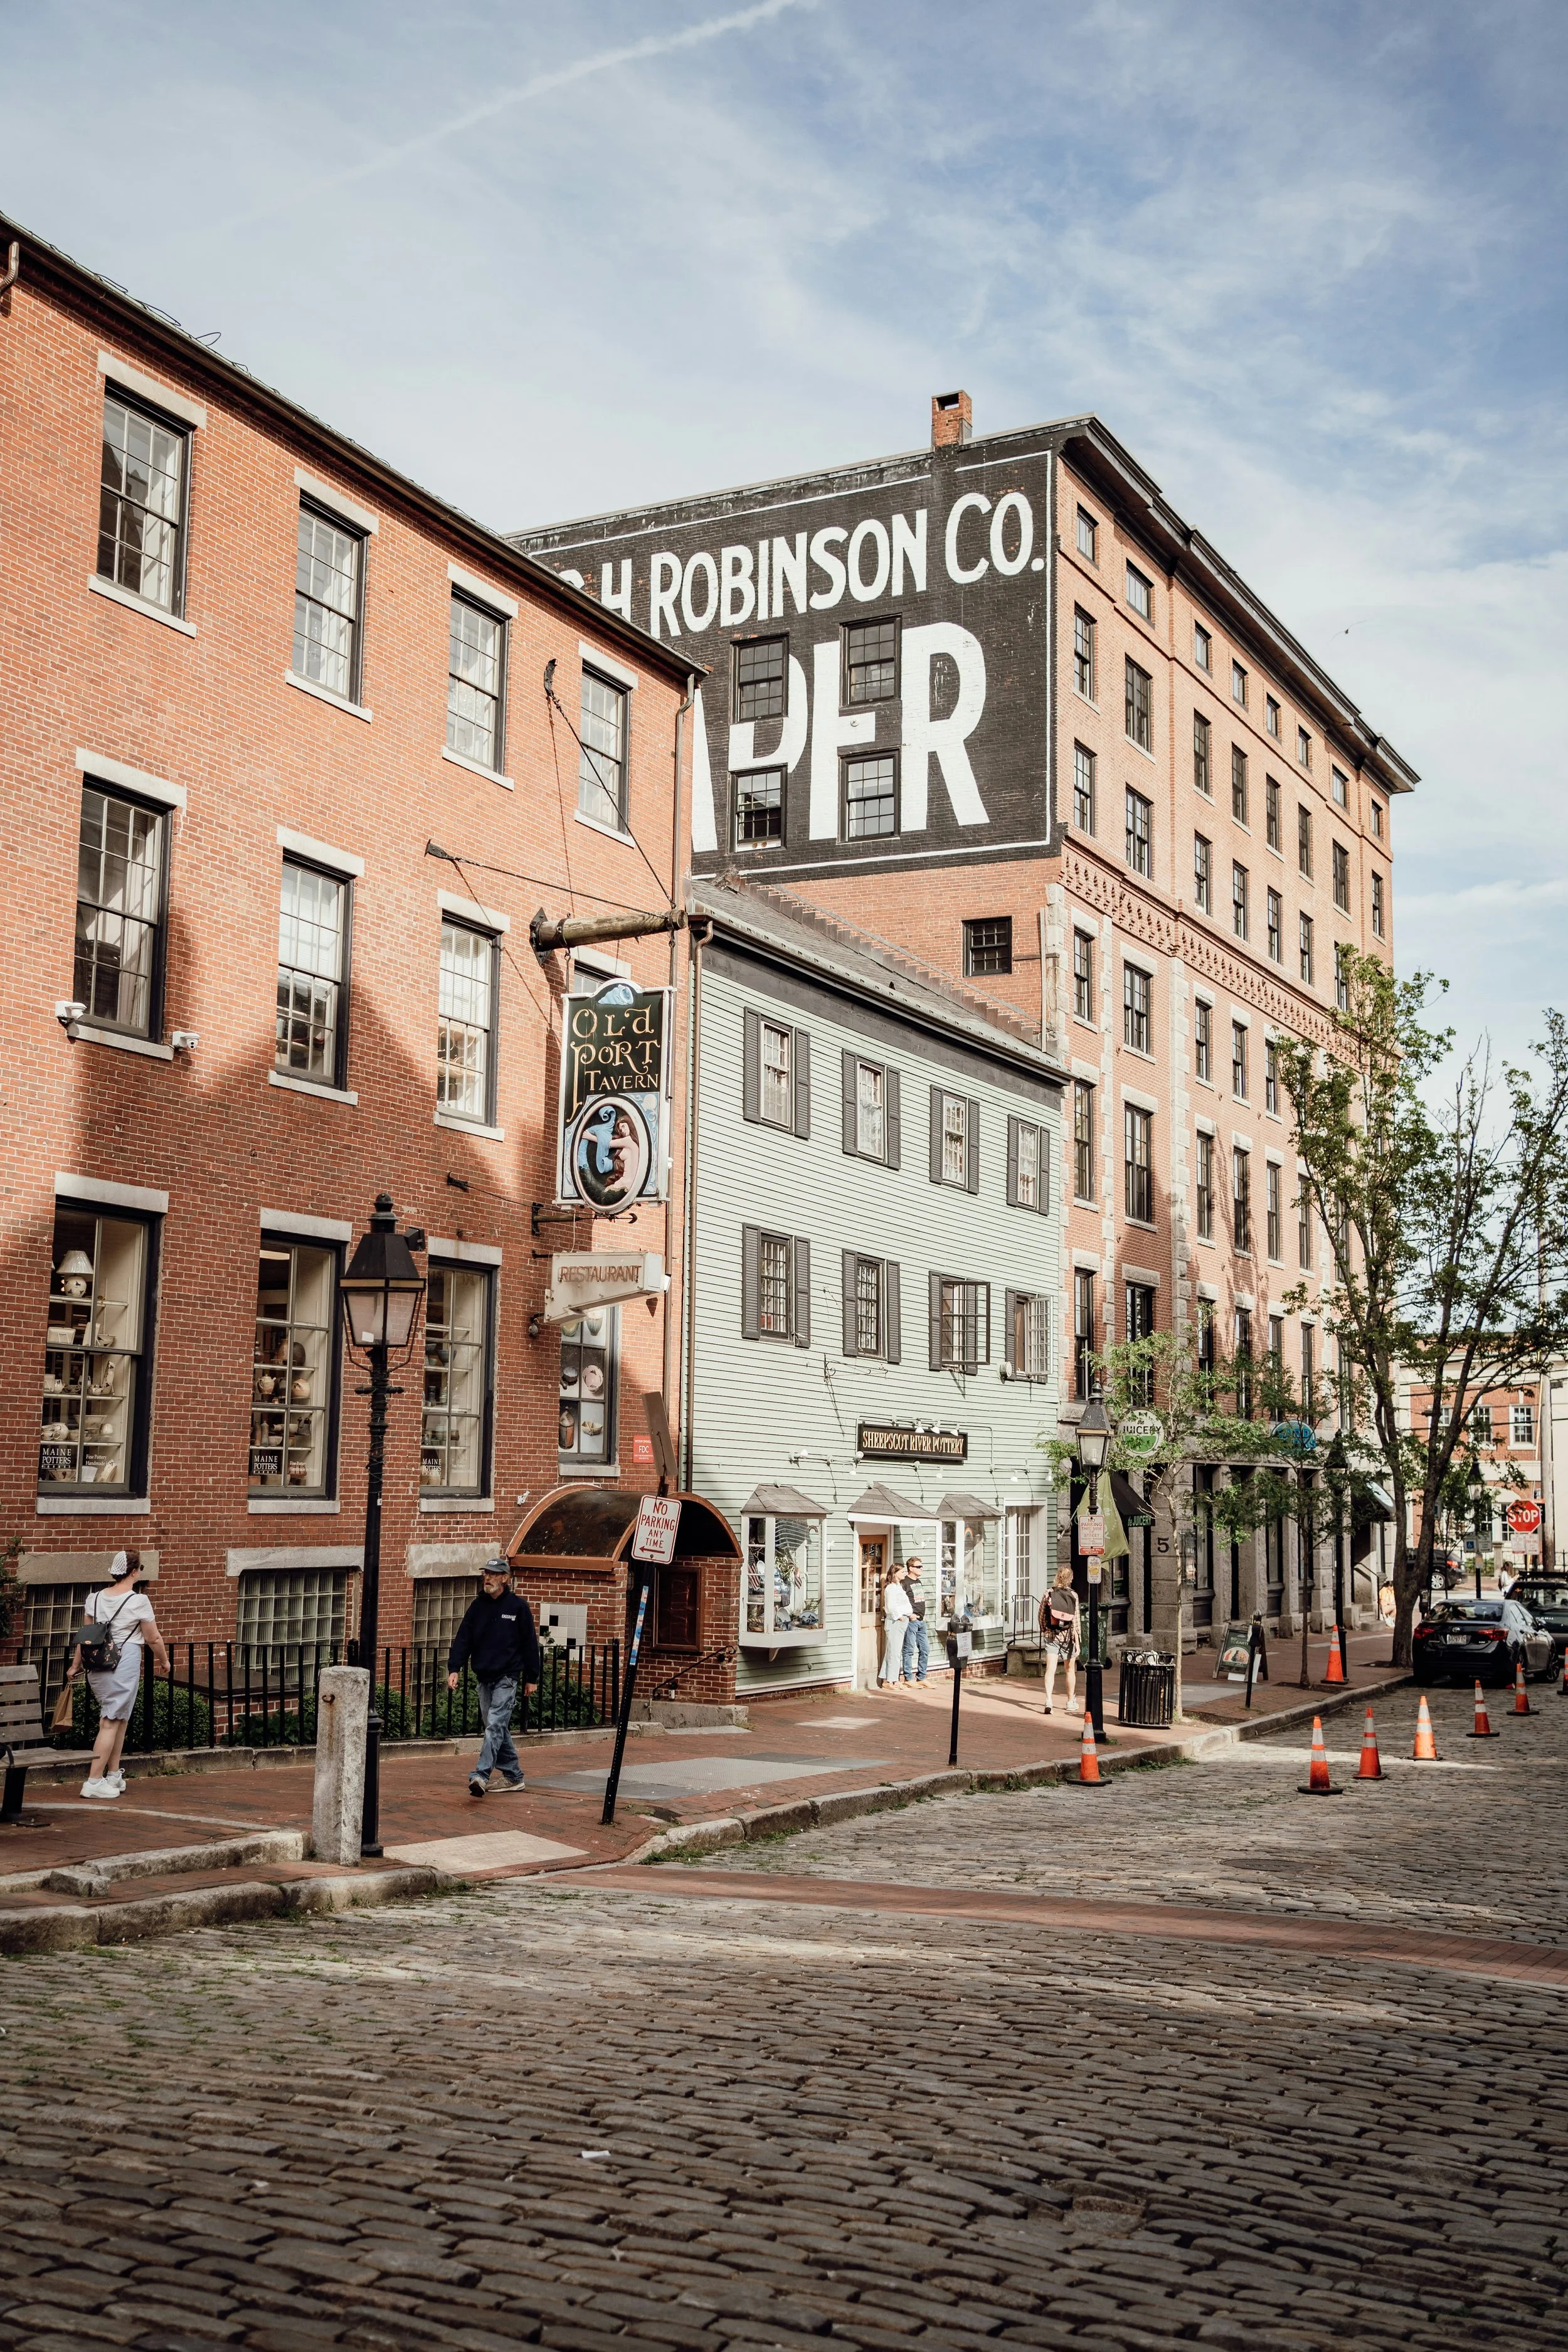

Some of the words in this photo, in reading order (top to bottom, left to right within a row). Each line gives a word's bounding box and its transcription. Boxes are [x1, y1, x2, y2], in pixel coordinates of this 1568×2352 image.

[650, 509, 928, 639] ROBINSON
[945, 492, 1046, 585] CO.
[559, 1265, 642, 1283] RESTAURANT
[638, 1445, 649, 1453] FDC
[862, 1431, 909, 1450] SHEEPSCOT
[909, 1434, 931, 1452] RIVER
[933, 1437, 963, 1454] POTTERY
[43, 1448, 72, 1456] MAINE
[42, 1456, 72, 1465] POTTERS
[653, 1502, 668, 1515] NO
[640, 1514, 675, 1531] PARKING
[1132, 1515, 1152, 1526] JUICERY
[1508, 1509, 1539, 1523] STOP
[648, 1529, 664, 1539] ANY
[645, 1537, 664, 1549] TIME
[1157, 1537, 1170, 1553] 5
